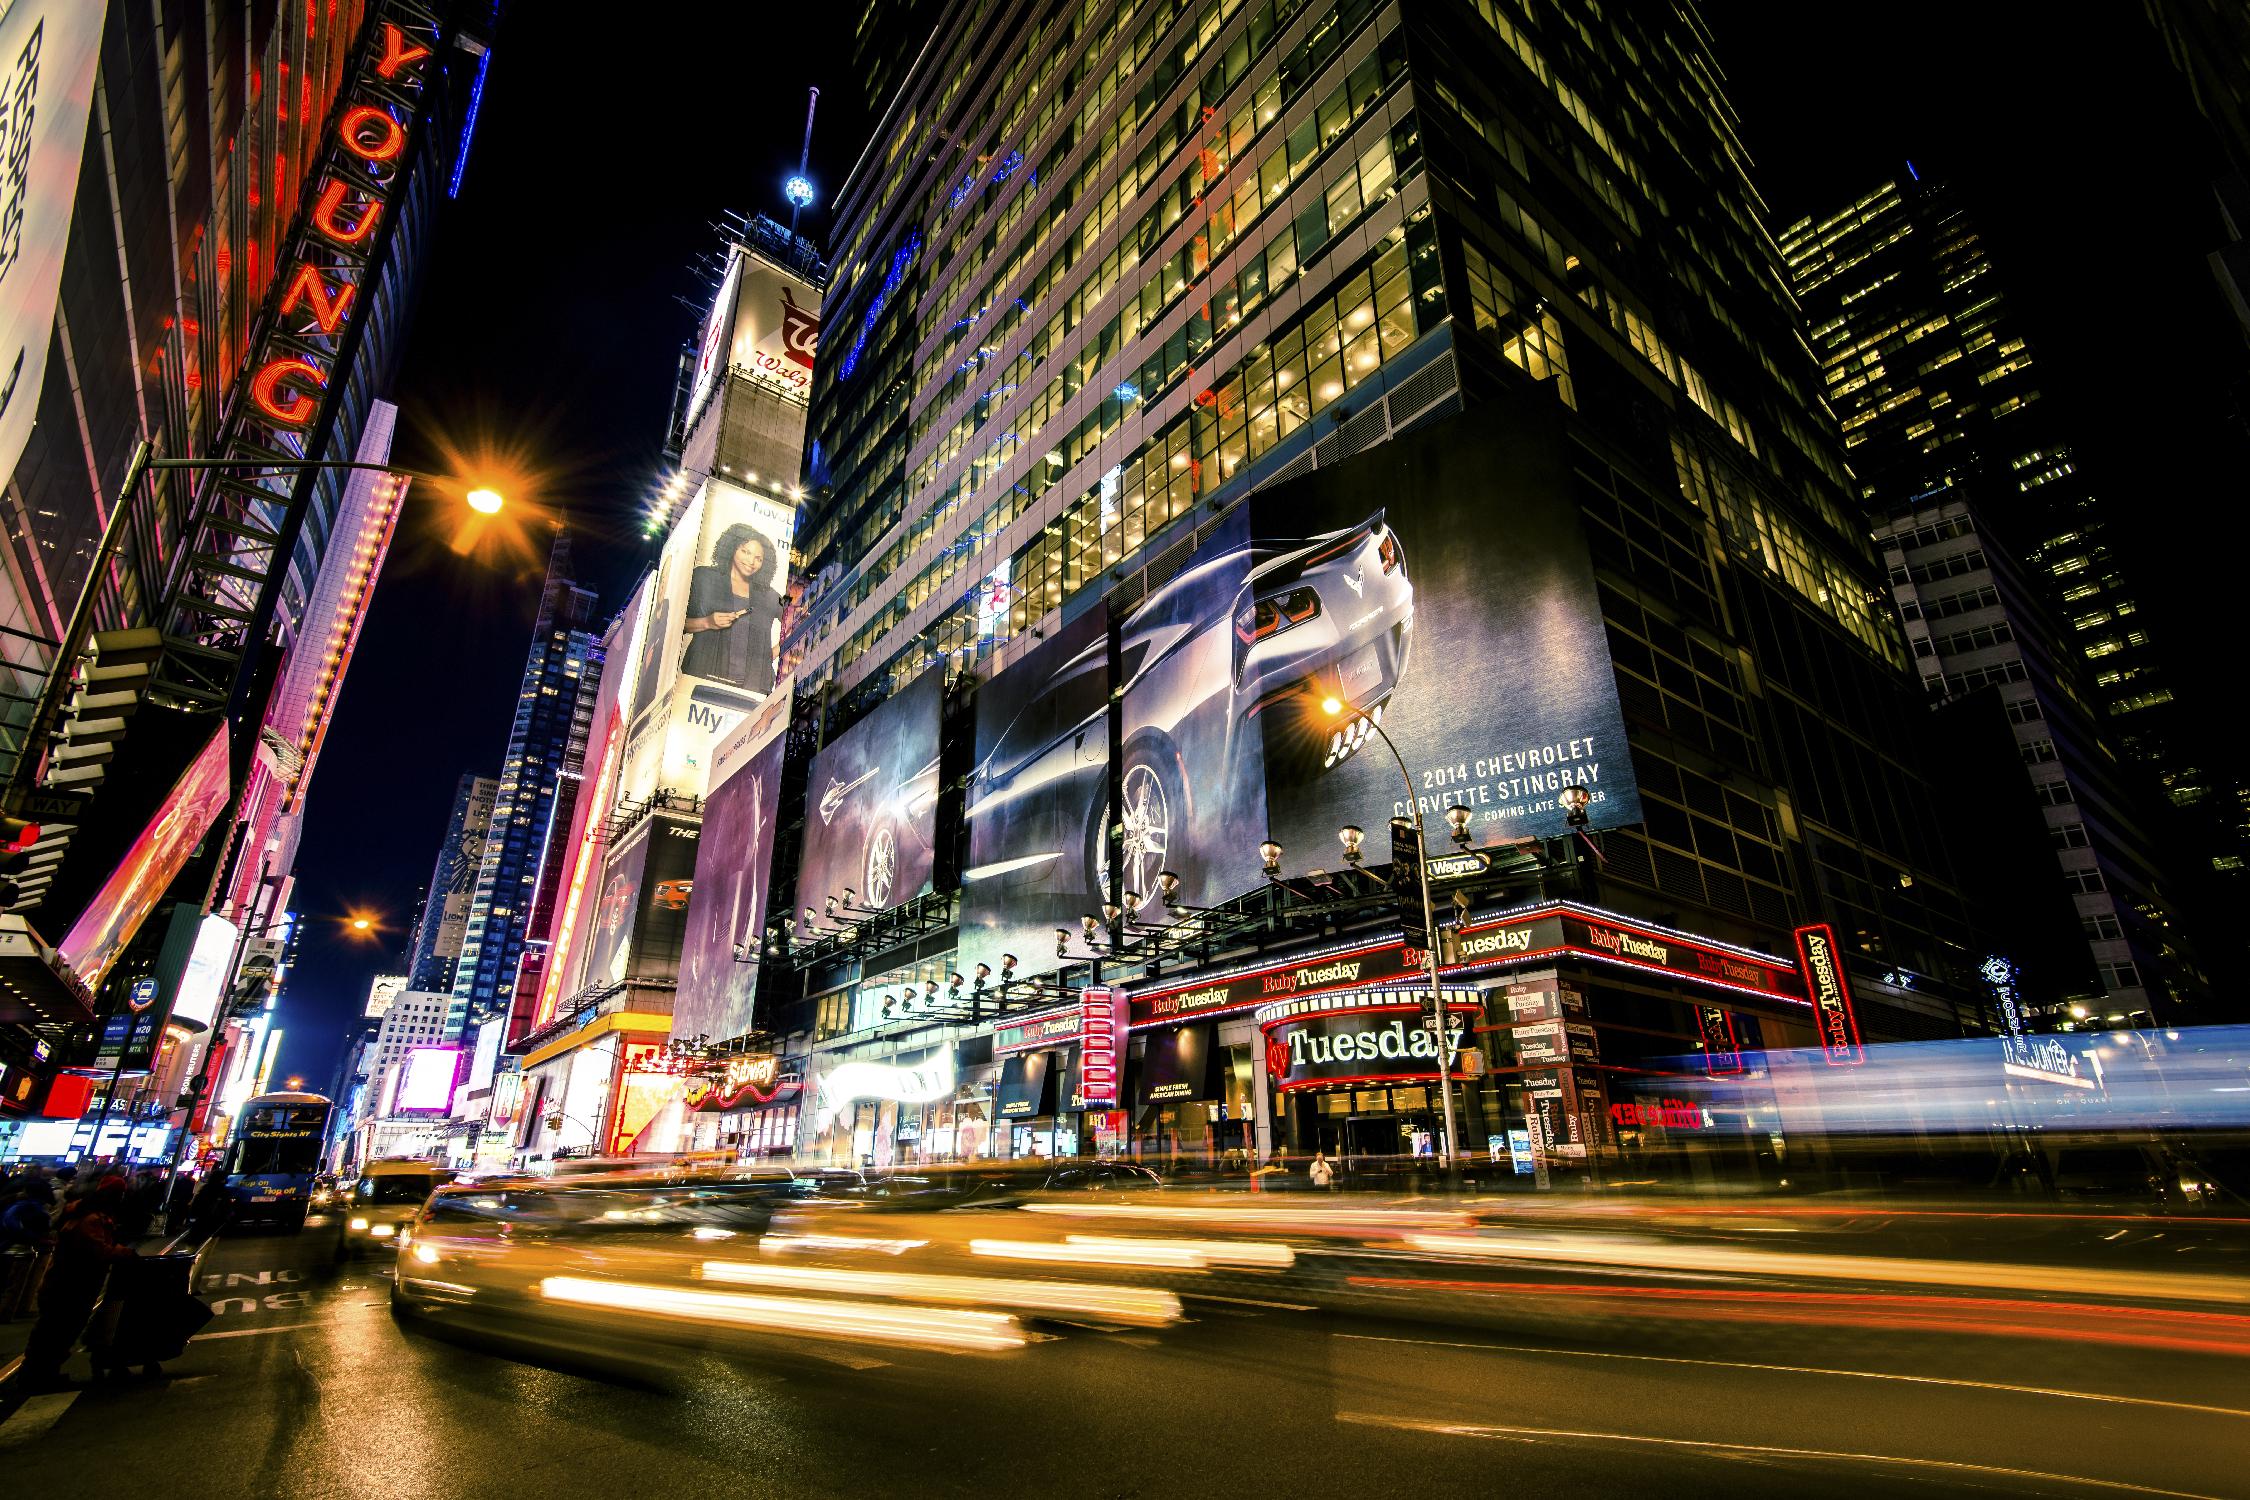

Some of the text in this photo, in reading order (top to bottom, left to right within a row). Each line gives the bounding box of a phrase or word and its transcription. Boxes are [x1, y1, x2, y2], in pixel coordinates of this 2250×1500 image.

[253, 24, 426, 424] YOUNG
[756, 351, 811, 387] Walg
[1424, 737, 1594, 789] 2014 CHEVROLET
[1394, 784, 1490, 818] CORVETTE
[1499, 763, 1599, 800] STINGRAY
[1484, 806, 1524, 821] COMING
[1529, 800, 1554, 814] LATE
[668, 827, 699, 838] THE
[1432, 860, 1480, 874] Wagner
[1460, 929, 1532, 955] uesday
[1588, 925, 1667, 965] Ruby Tuesday
[1262, 962, 1360, 992] Ruby Tuesday
[1152, 988, 1229, 1014] Ruby Tuesday
[1808, 934, 1851, 1058] Ruby Tuesday
[1044, 1018, 1079, 1034] Tuesday
[1288, 1020, 1464, 1068] Tuesday
[1524, 1078, 1556, 1087] Tuesday
[1530, 1116, 1540, 1148] Ruby
[1540, 1099, 1555, 1152] Tuesday
[1569, 1114, 1579, 1142] Ruby
[262, 1186, 297, 1196] Hop off
